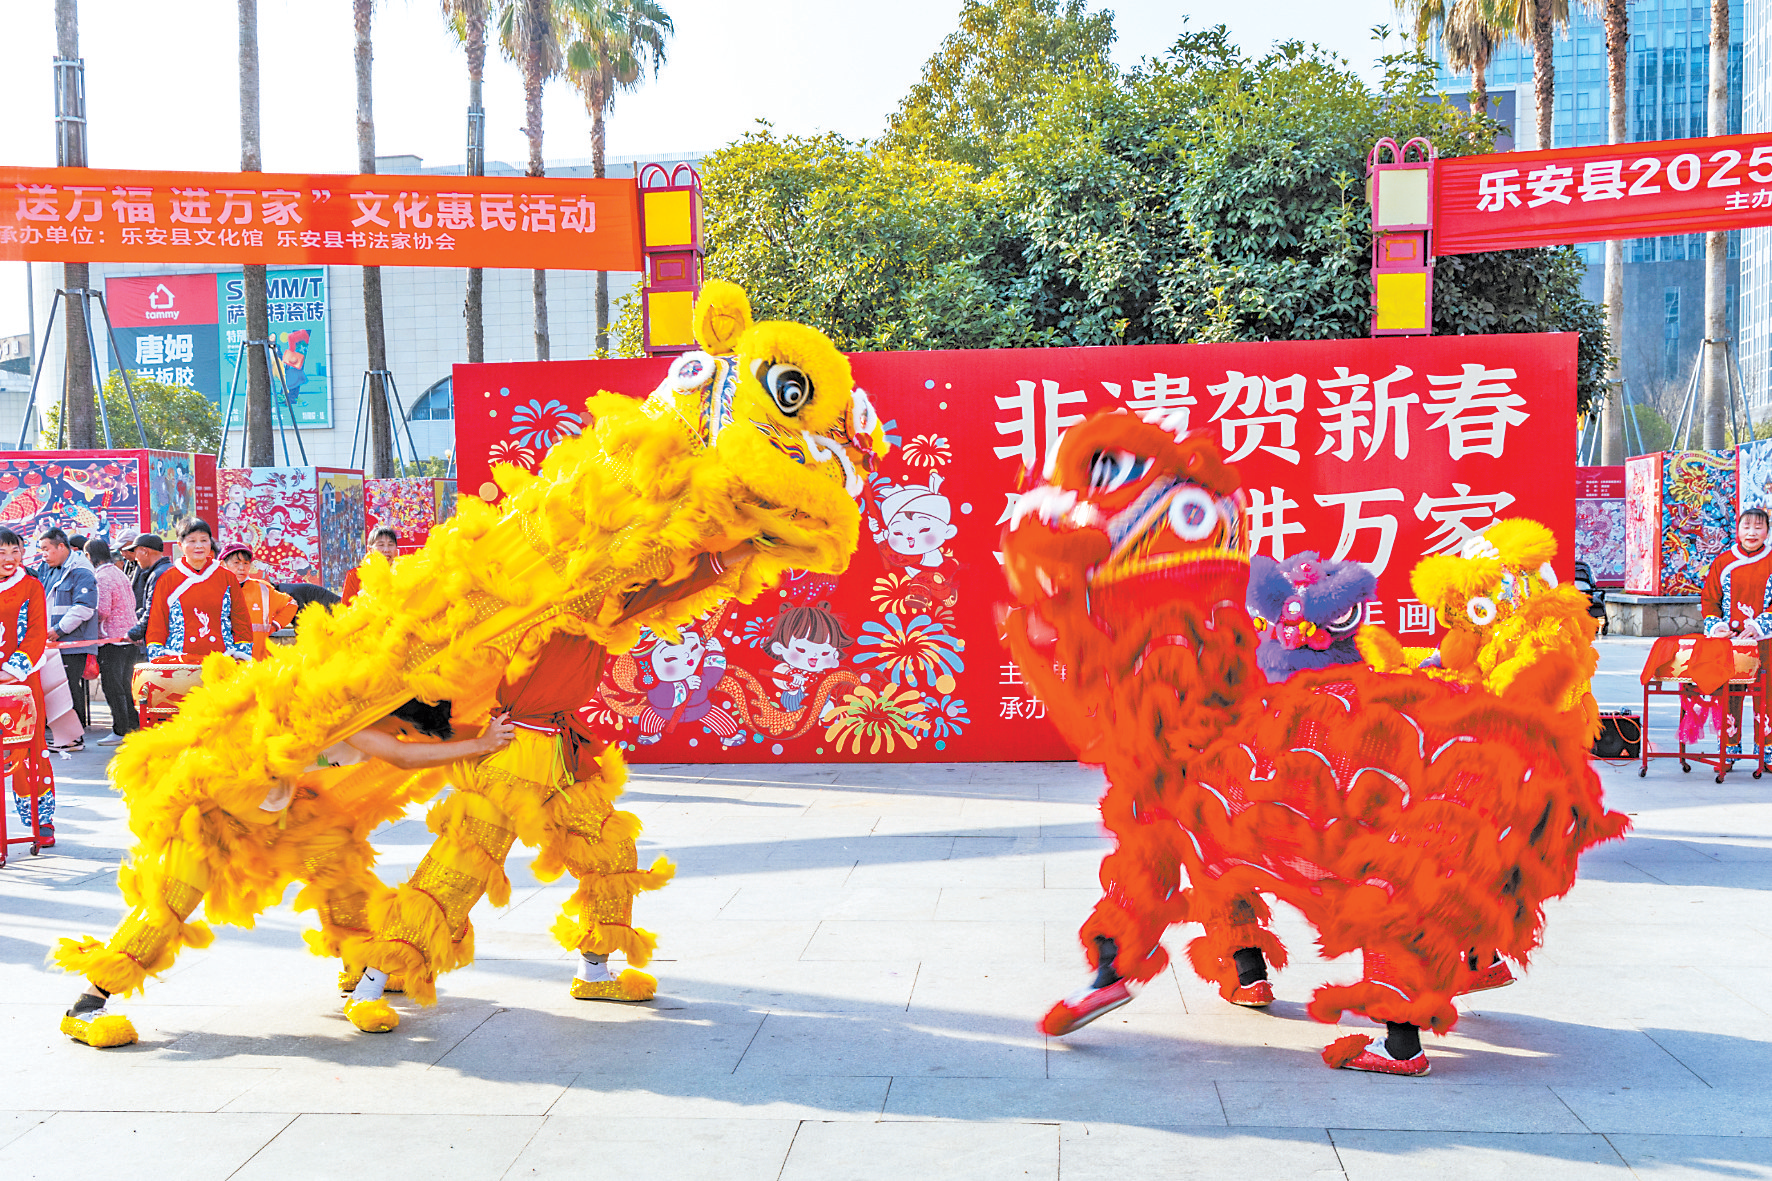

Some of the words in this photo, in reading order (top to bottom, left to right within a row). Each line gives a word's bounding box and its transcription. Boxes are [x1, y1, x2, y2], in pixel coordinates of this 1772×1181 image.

[1477, 146, 1772, 212] 乐安县2025
[15, 183, 155, 225] 送万福
[350, 191, 597, 233] 文化惠民活动
[277, 230, 456, 250] 乐安县书法家协会
[226, 277, 324, 302] SMMIT
[145, 310, 180, 320] tammy
[226, 302, 325, 324] 萨特瓷砖
[135, 333, 194, 365] 唐姆
